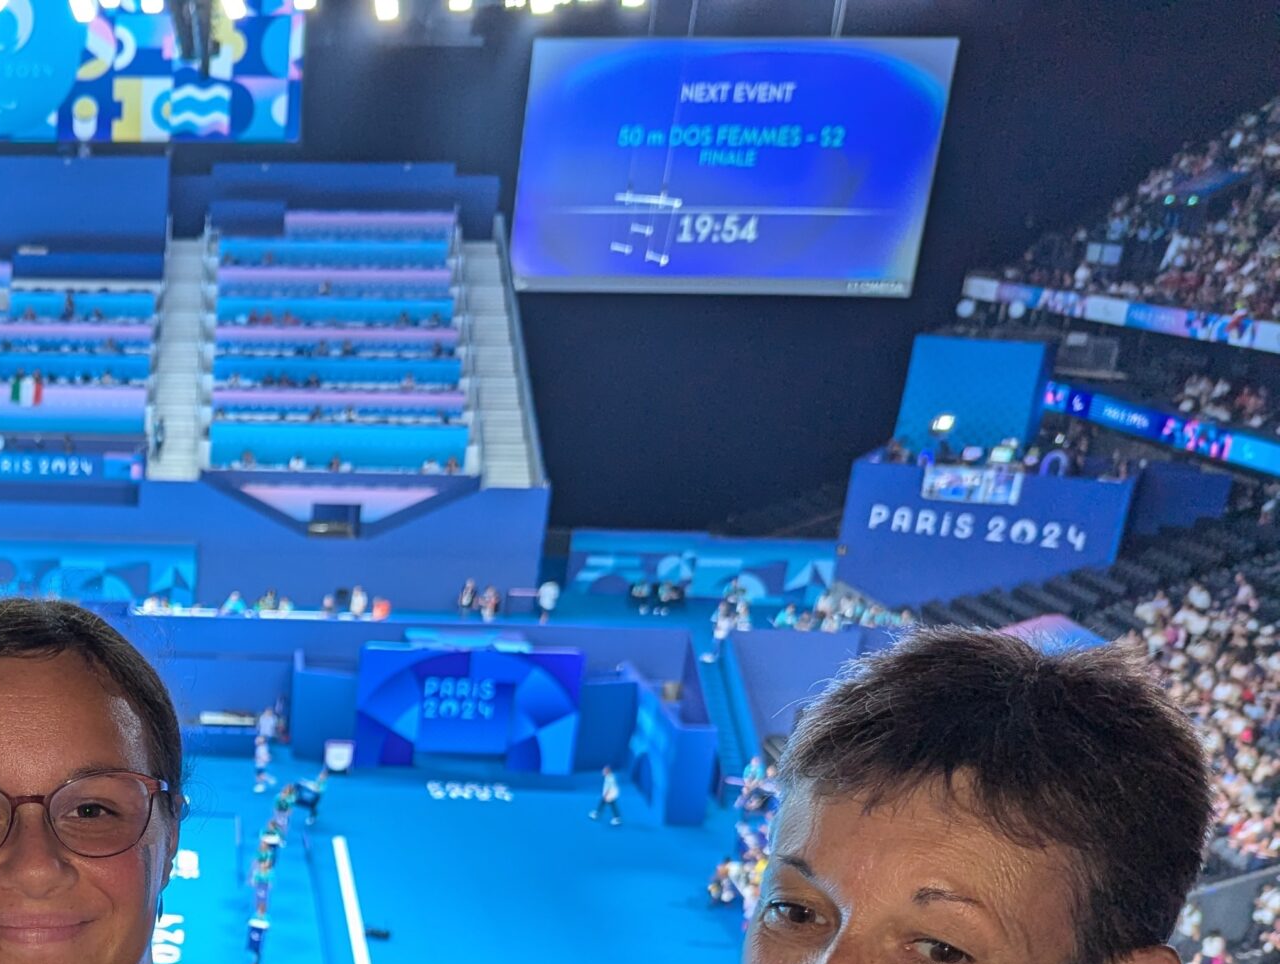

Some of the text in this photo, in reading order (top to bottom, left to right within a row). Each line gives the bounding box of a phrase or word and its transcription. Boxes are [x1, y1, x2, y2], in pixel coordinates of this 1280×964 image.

[680, 81, 797, 103] NEXT EVENT
[617, 124, 645, 147] 50
[646, 129, 666, 147] m
[669, 124, 713, 147] DOS
[716, 124, 803, 148] FEMMES
[820, 125, 847, 148] S2
[698, 148, 758, 167] FINALE
[676, 214, 759, 243] 19:54
[38, 456, 93, 476] 2024
[868, 503, 1086, 551] PARIS 2024
[423, 676, 496, 700] PARIS
[423, 698, 495, 720] 2024
